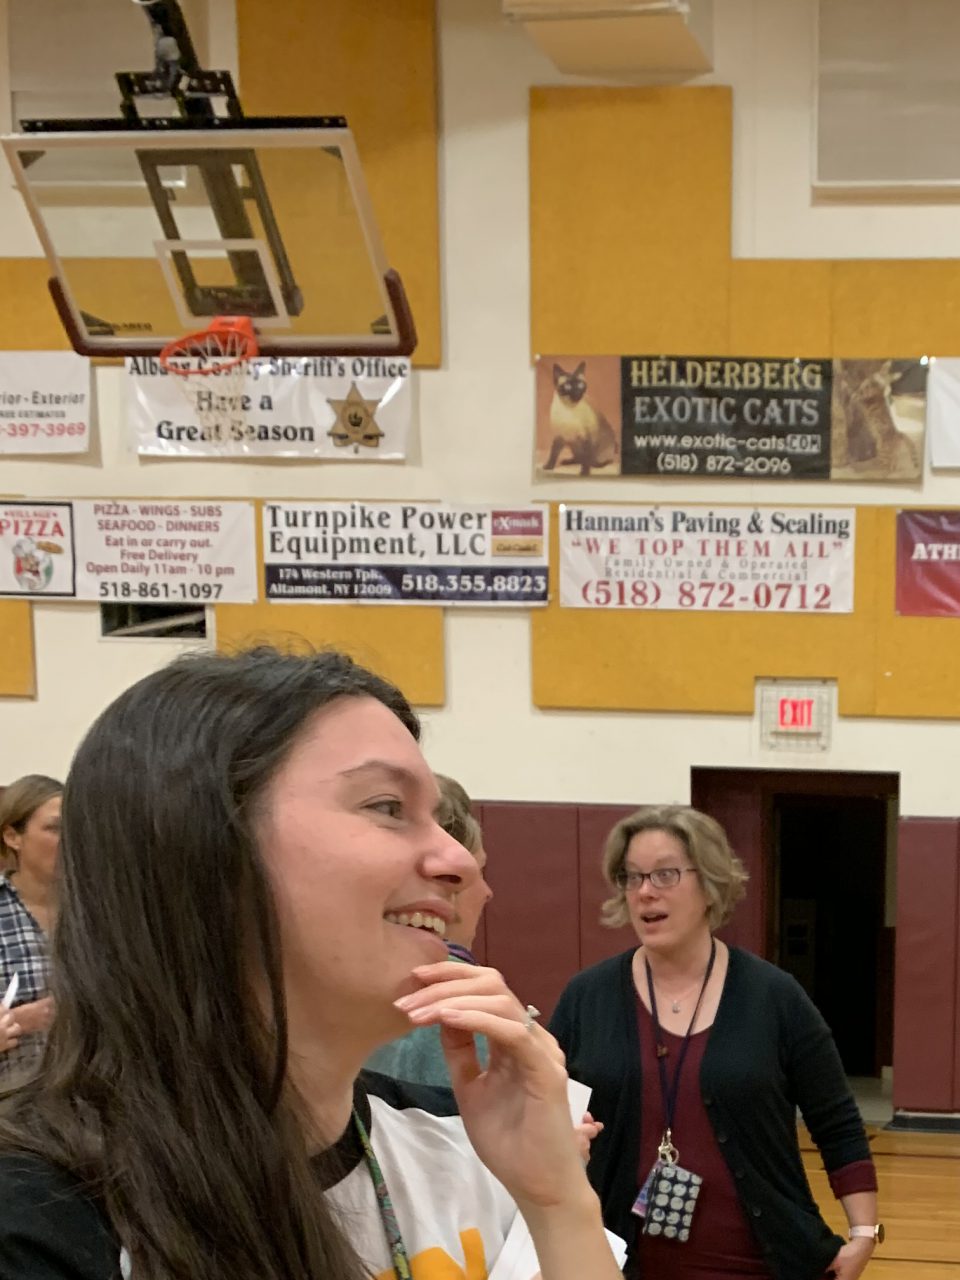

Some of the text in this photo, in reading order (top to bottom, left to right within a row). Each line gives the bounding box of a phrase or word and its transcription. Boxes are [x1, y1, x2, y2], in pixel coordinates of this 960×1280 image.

[197, 357, 262, 381] Couty
[351, 357, 408, 379] Office
[631, 360, 822, 391] HELDERBERG
[31, 390, 86, 405] Exterior
[196, 389, 274, 412] Have a
[634, 396, 820, 427] EXOTIC CATS
[157, 420, 316, 444] Great Season
[657, 452, 792, 475] (518) 872-2096
[93, 503, 130, 517] PIZZA
[138, 504, 181, 517] WINGS
[190, 504, 222, 518] SUBS
[267, 504, 488, 535] Turnpike Power
[0, 518, 65, 537] PIZZA
[97, 518, 156, 532] SEAFOOD
[166, 519, 220, 533] DINNERS
[564, 508, 851, 540] Hannan's Paving & Sealing
[105, 535, 130, 548] Eat
[132, 535, 139, 548] in
[140, 537, 153, 548] or
[156, 538, 188, 552] carry
[269, 530, 487, 562] Equipment, LLC
[636, 537, 686, 556] TOP
[697, 538, 771, 558] THEM
[120, 549, 198, 564] Free Delivery
[663, 556, 713, 569] Owned
[86, 562, 118, 576] Open
[120, 562, 152, 577] Daily
[154, 562, 188, 575] 11am
[197, 563, 213, 576] 10
[215, 565, 236, 578] pm
[278, 568, 299, 580] 174
[301, 568, 353, 580] Western
[99, 581, 224, 600] 518-861-1097
[269, 582, 393, 596] Altamont, NY 12009
[401, 573, 547, 594] 518.355.8823
[581, 580, 832, 609] (518) 872-0712
